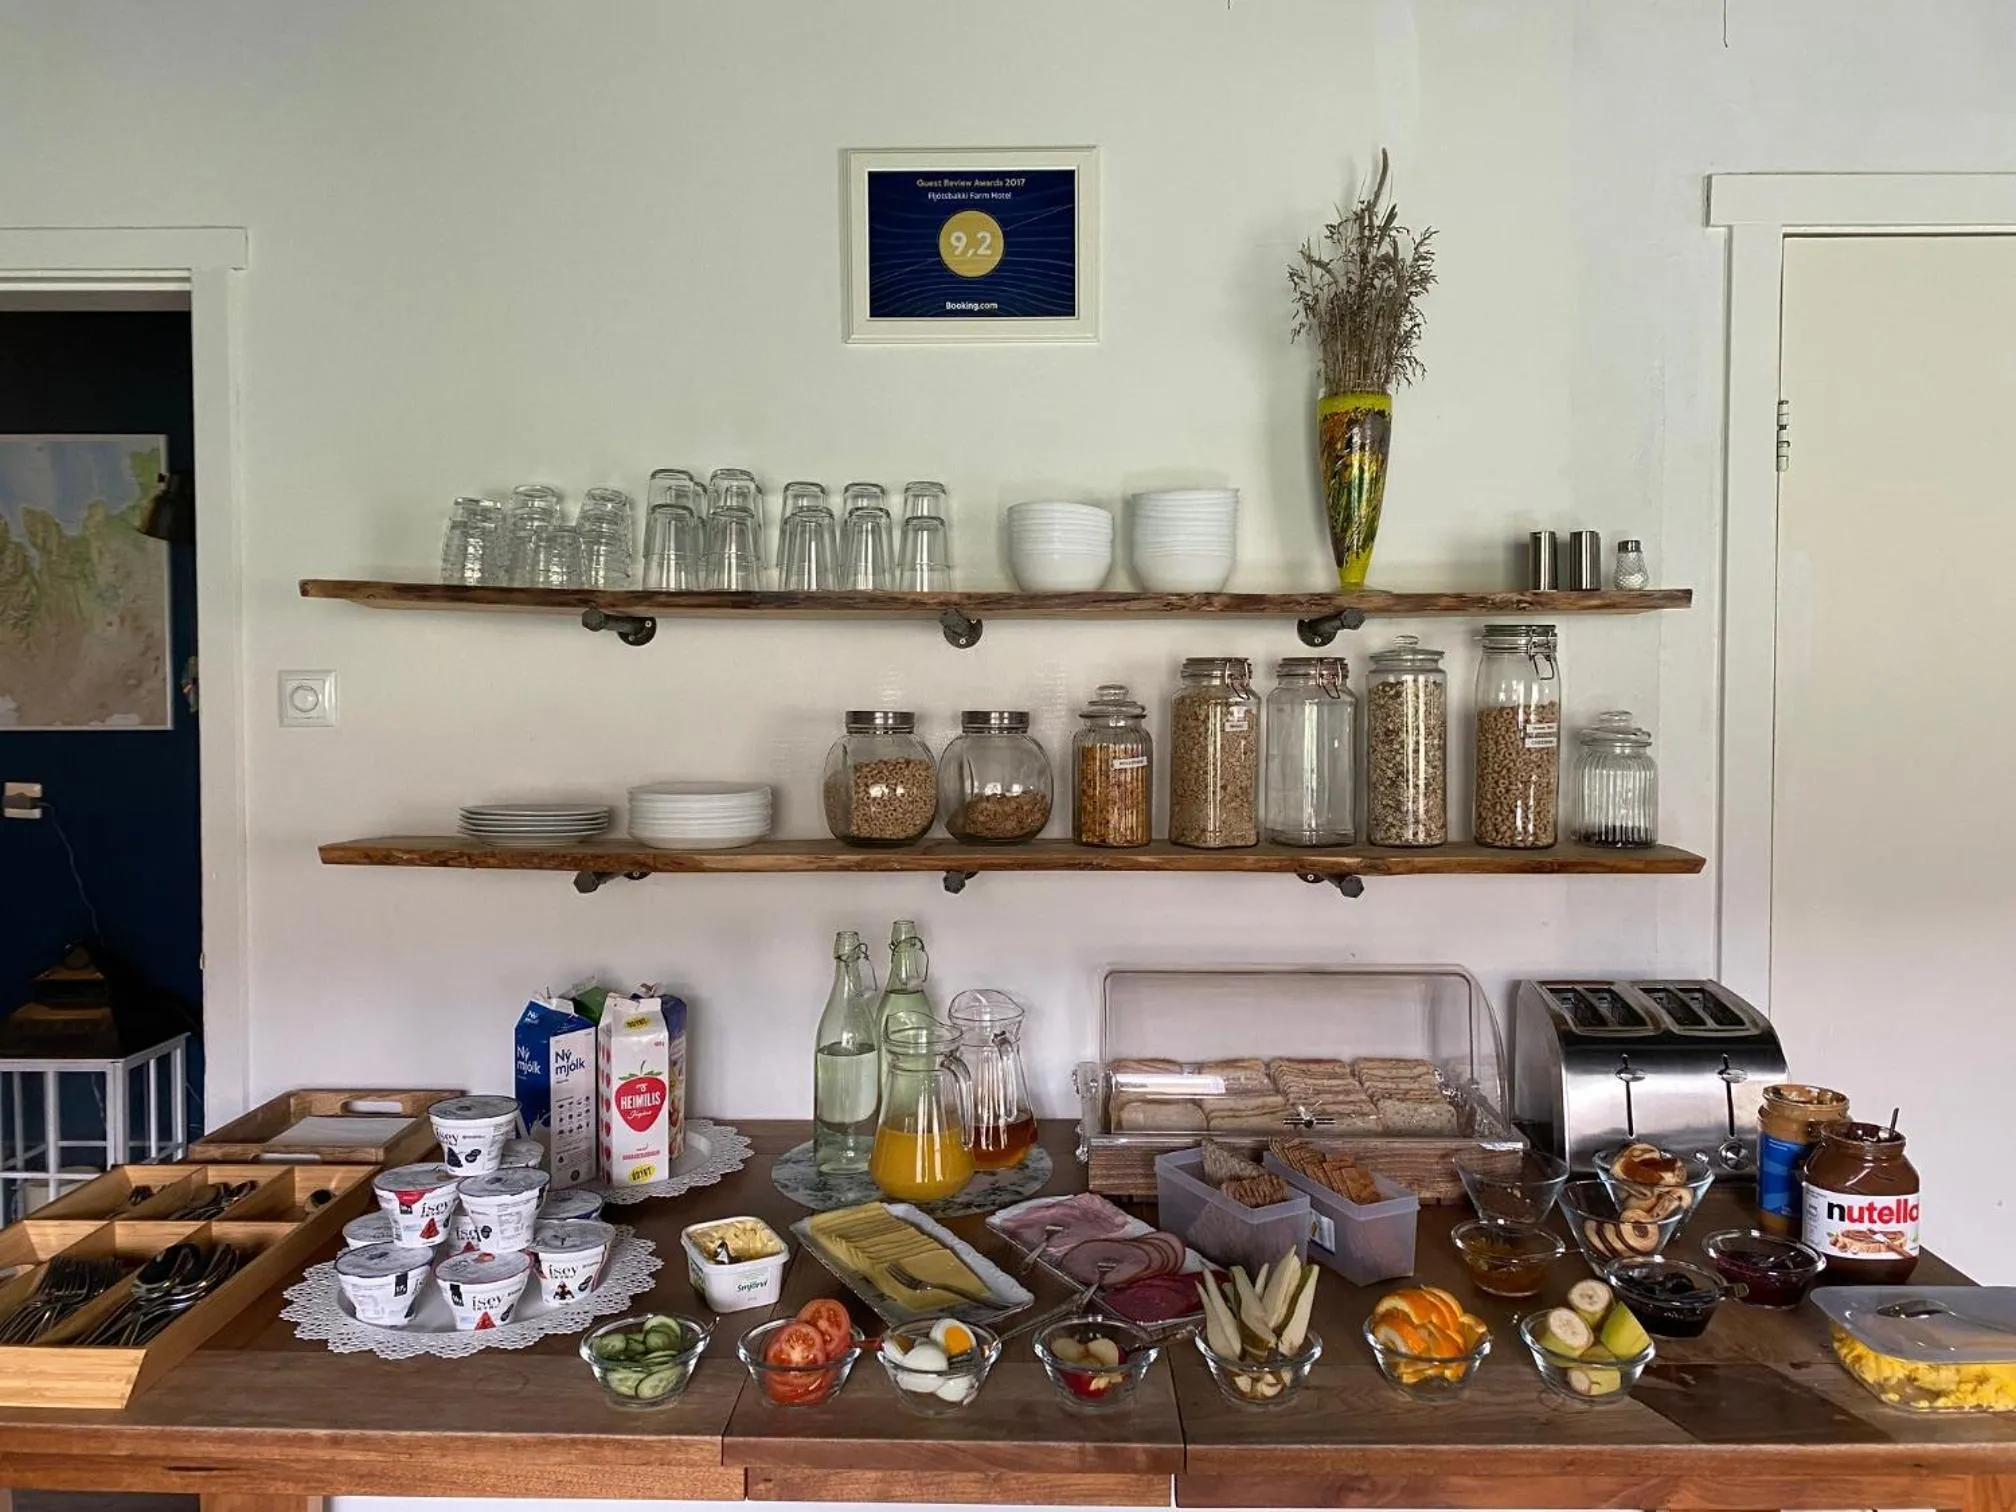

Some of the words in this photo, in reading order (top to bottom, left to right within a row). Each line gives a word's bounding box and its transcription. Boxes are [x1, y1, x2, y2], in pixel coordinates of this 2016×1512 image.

[916, 179, 942, 187] Guest
[943, 179, 972, 187] Review
[973, 179, 1003, 187] Awards
[1004, 178, 1026, 187] 2017
[970, 191, 990, 199] Farm
[991, 191, 1012, 199] Hotel
[950, 231, 992, 257] 9,2
[945, 301, 998, 311] Booking.com
[620, 1091, 661, 1110] HEIMILIS
[1827, 1199, 1919, 1224] nutella
